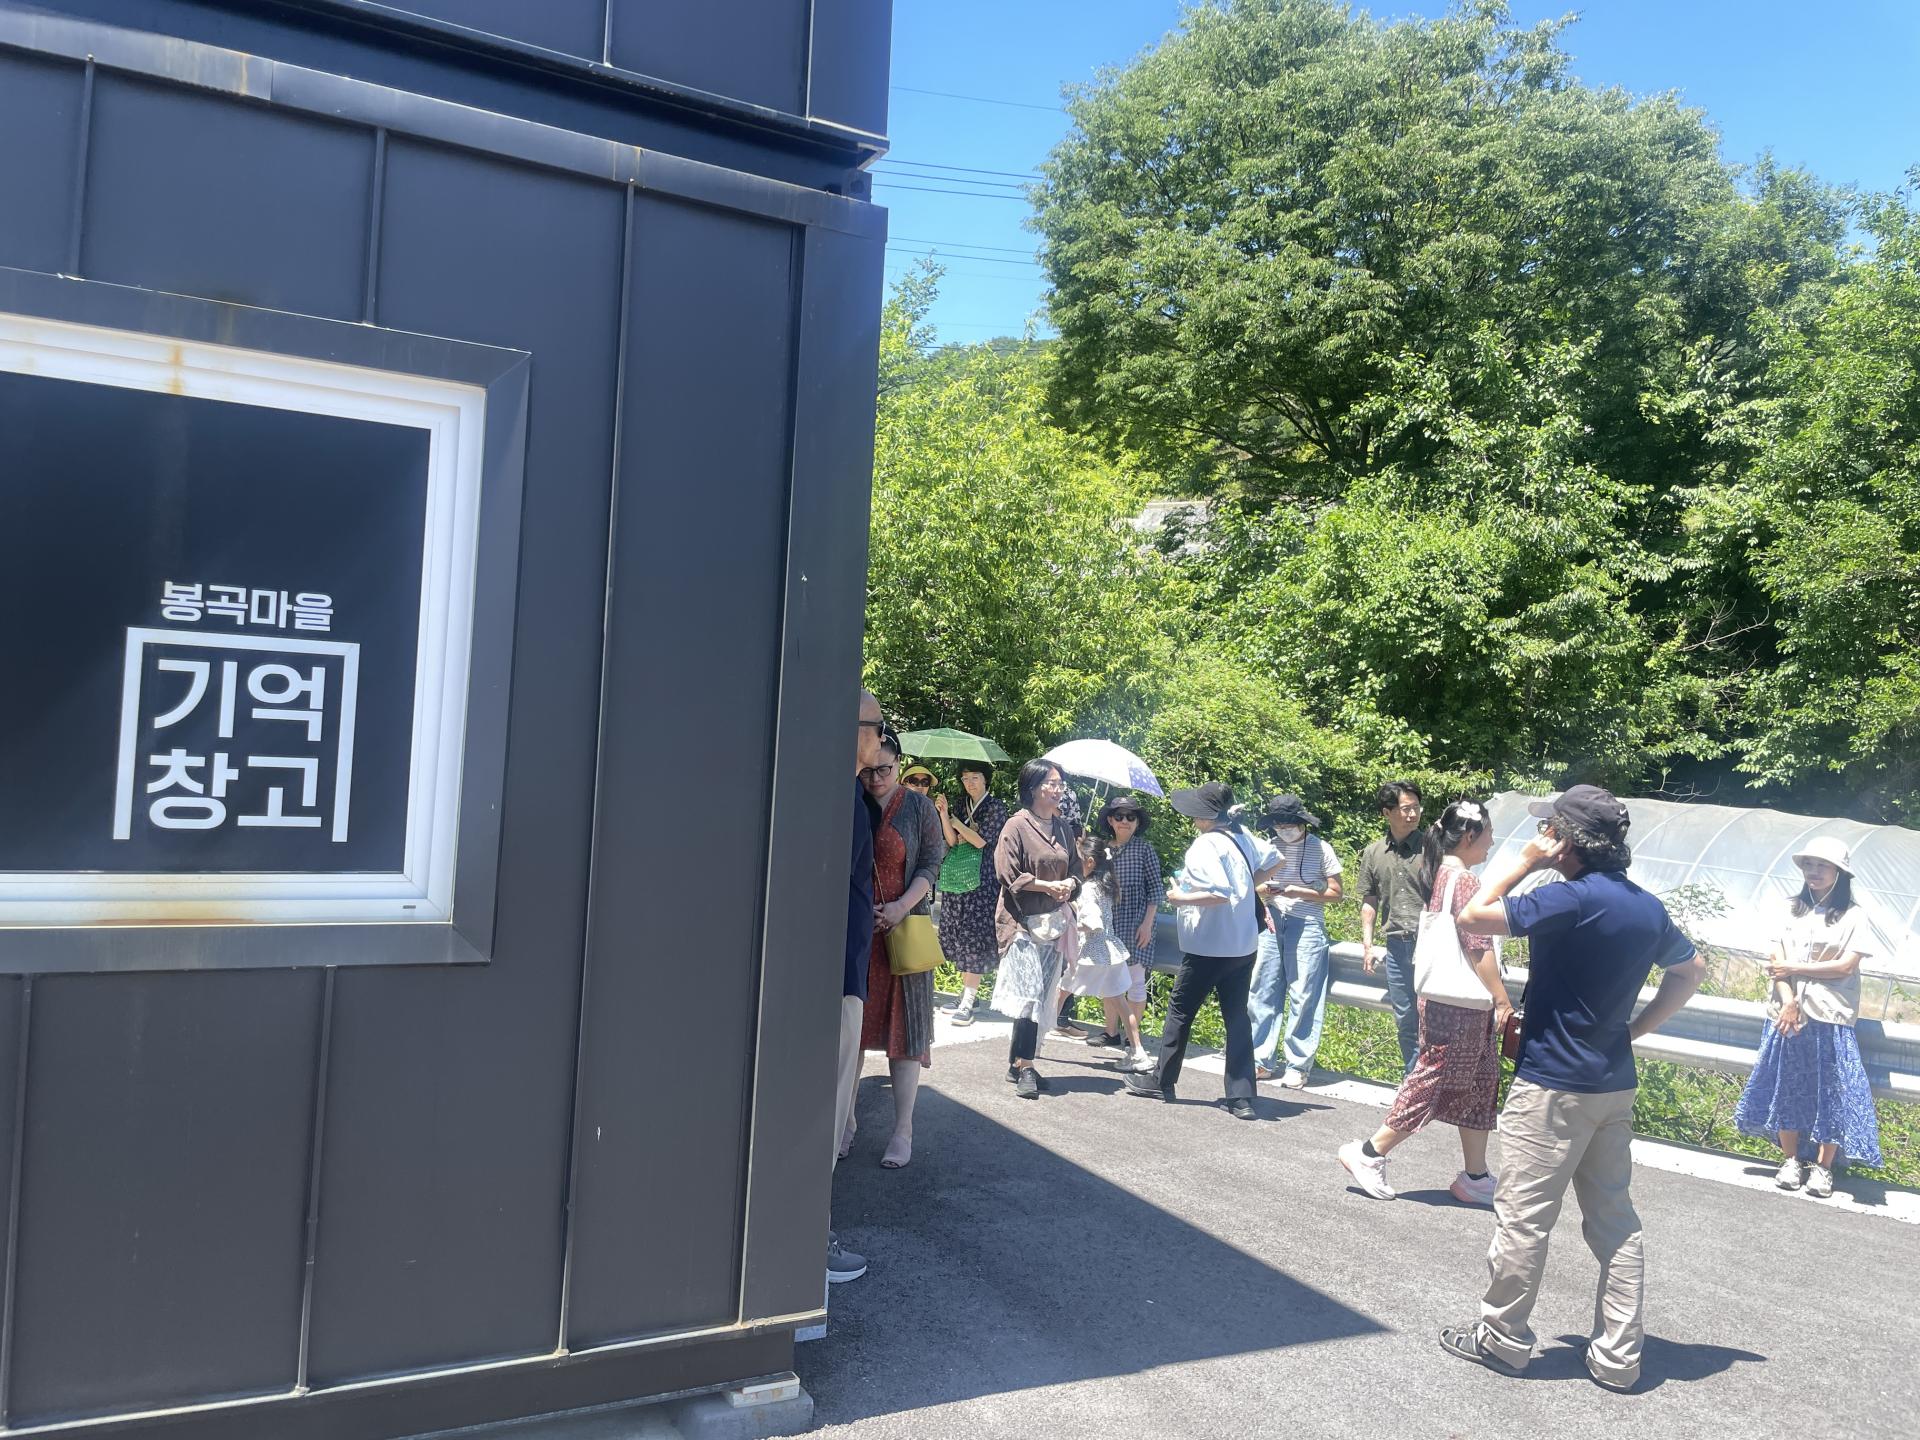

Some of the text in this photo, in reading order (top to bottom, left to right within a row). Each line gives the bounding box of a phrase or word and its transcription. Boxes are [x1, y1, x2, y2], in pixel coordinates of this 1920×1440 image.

[160, 580, 334, 632] 봉곡마을
[153, 658, 326, 742] 기억
[146, 748, 323, 830] 창고
